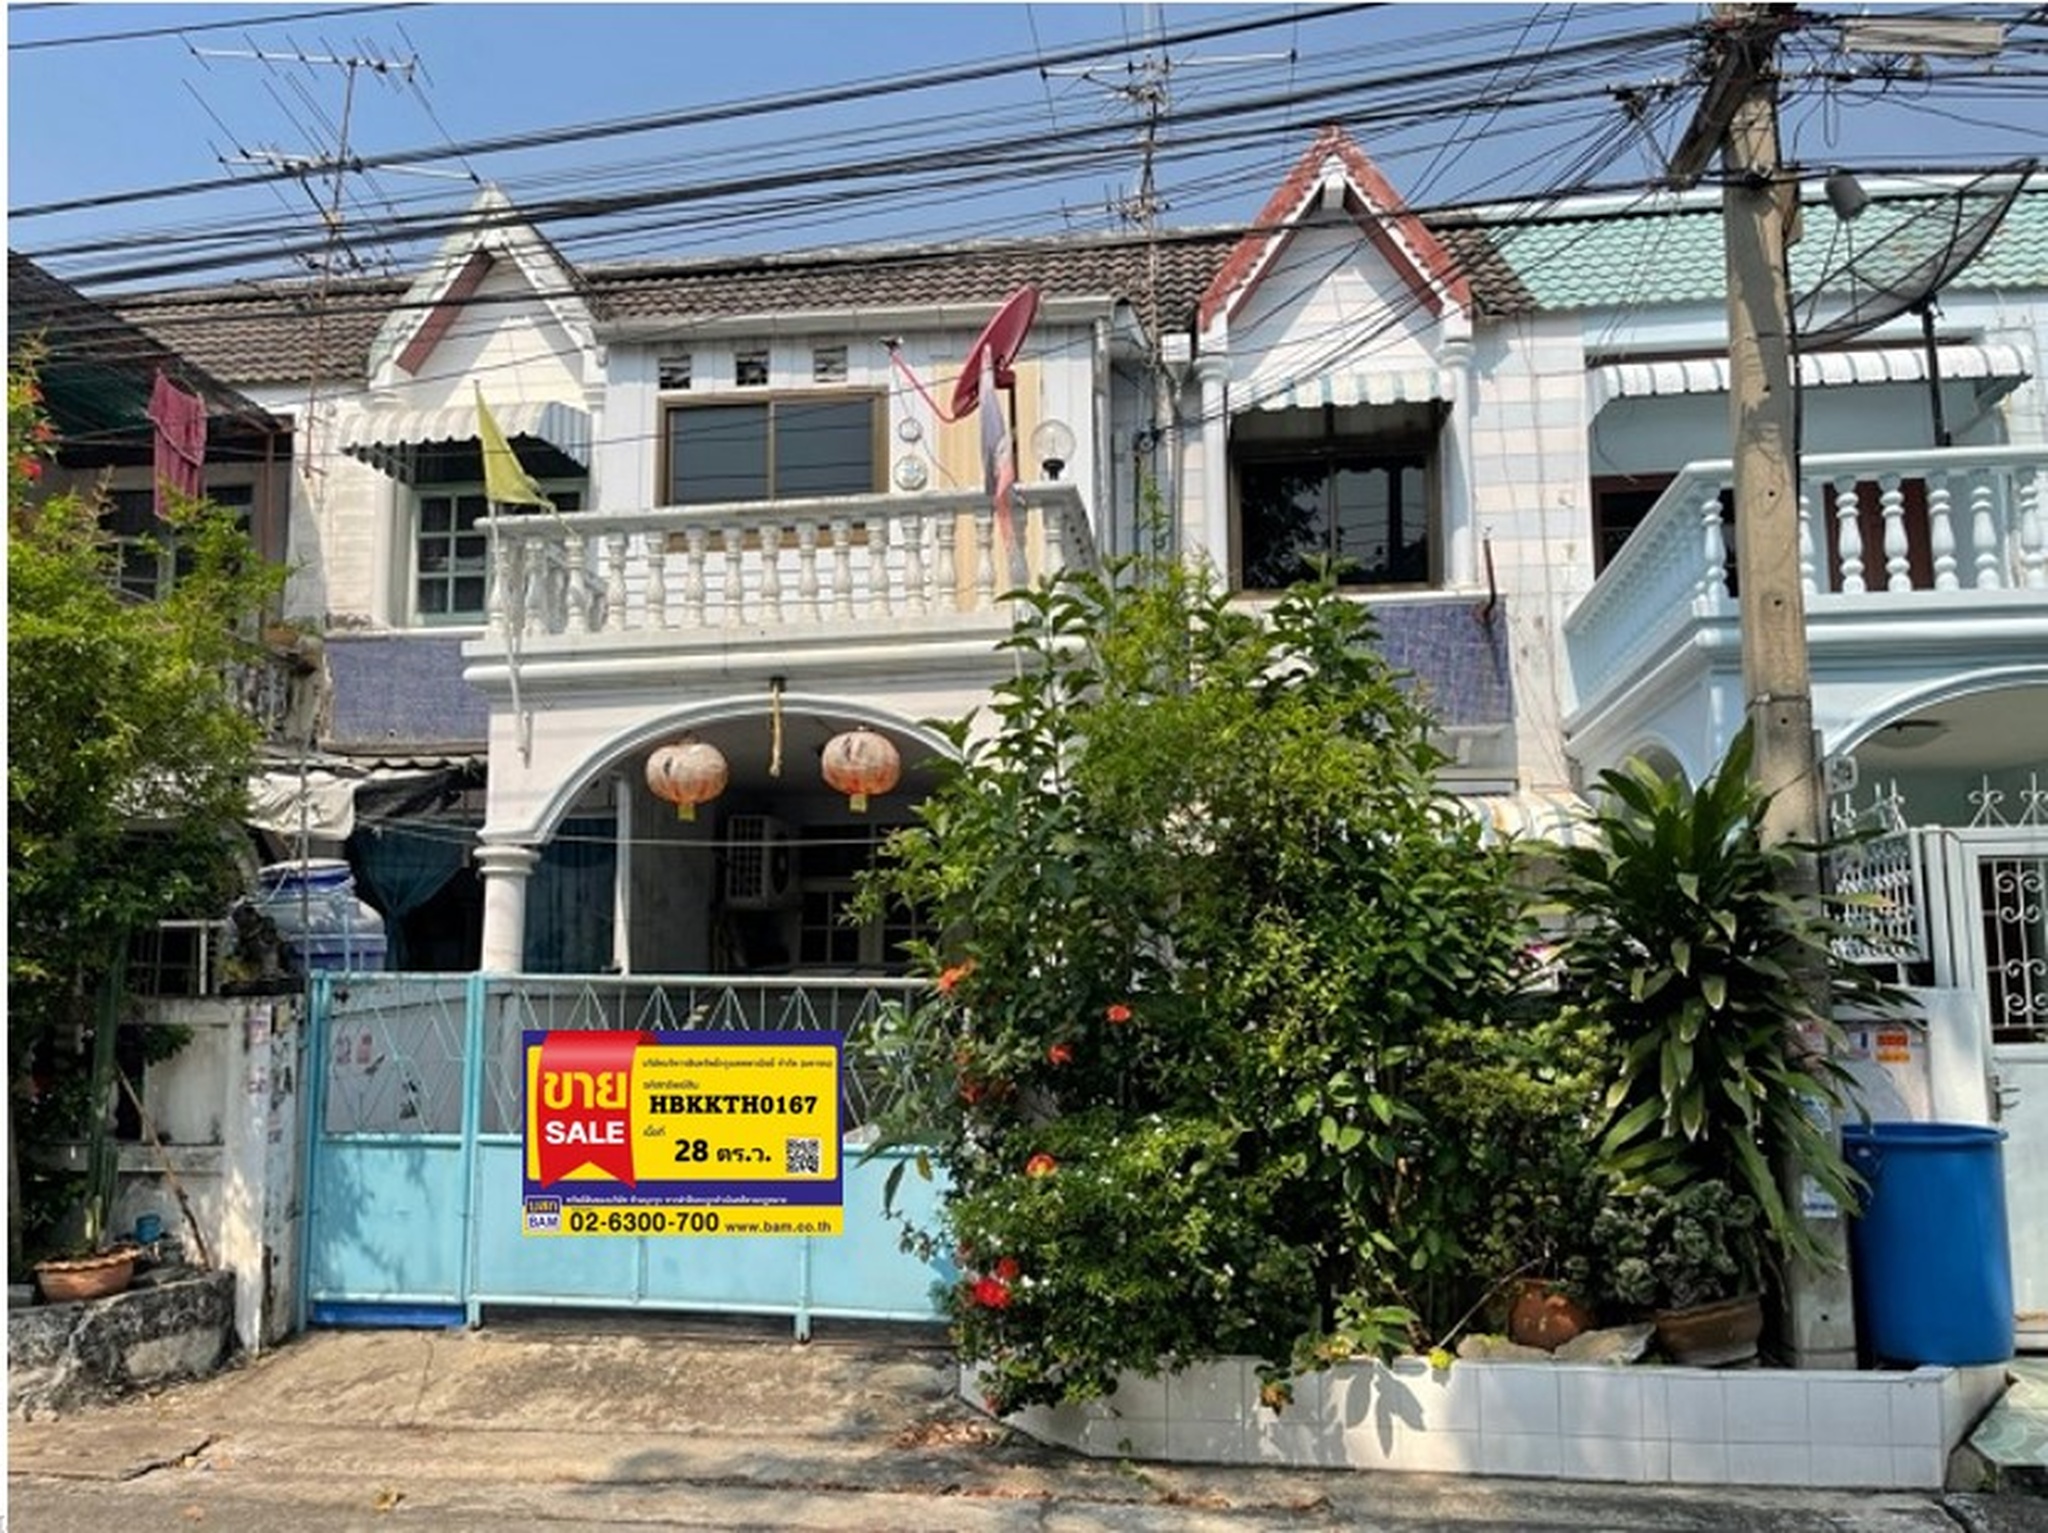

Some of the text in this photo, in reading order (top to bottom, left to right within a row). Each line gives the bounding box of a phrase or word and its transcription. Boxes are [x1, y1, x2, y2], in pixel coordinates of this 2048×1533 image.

[544, 1072, 627, 1109] ขาย
[649, 1095, 818, 1114] HBKKTH0167
[545, 1121, 625, 1144] SALE
[674, 1139, 772, 1162] 28 ตร.ว.
[529, 1216, 558, 1228] BAM
[570, 1212, 719, 1233] 02-6300-700
[725, 1220, 832, 1233] www.bam.co.th
